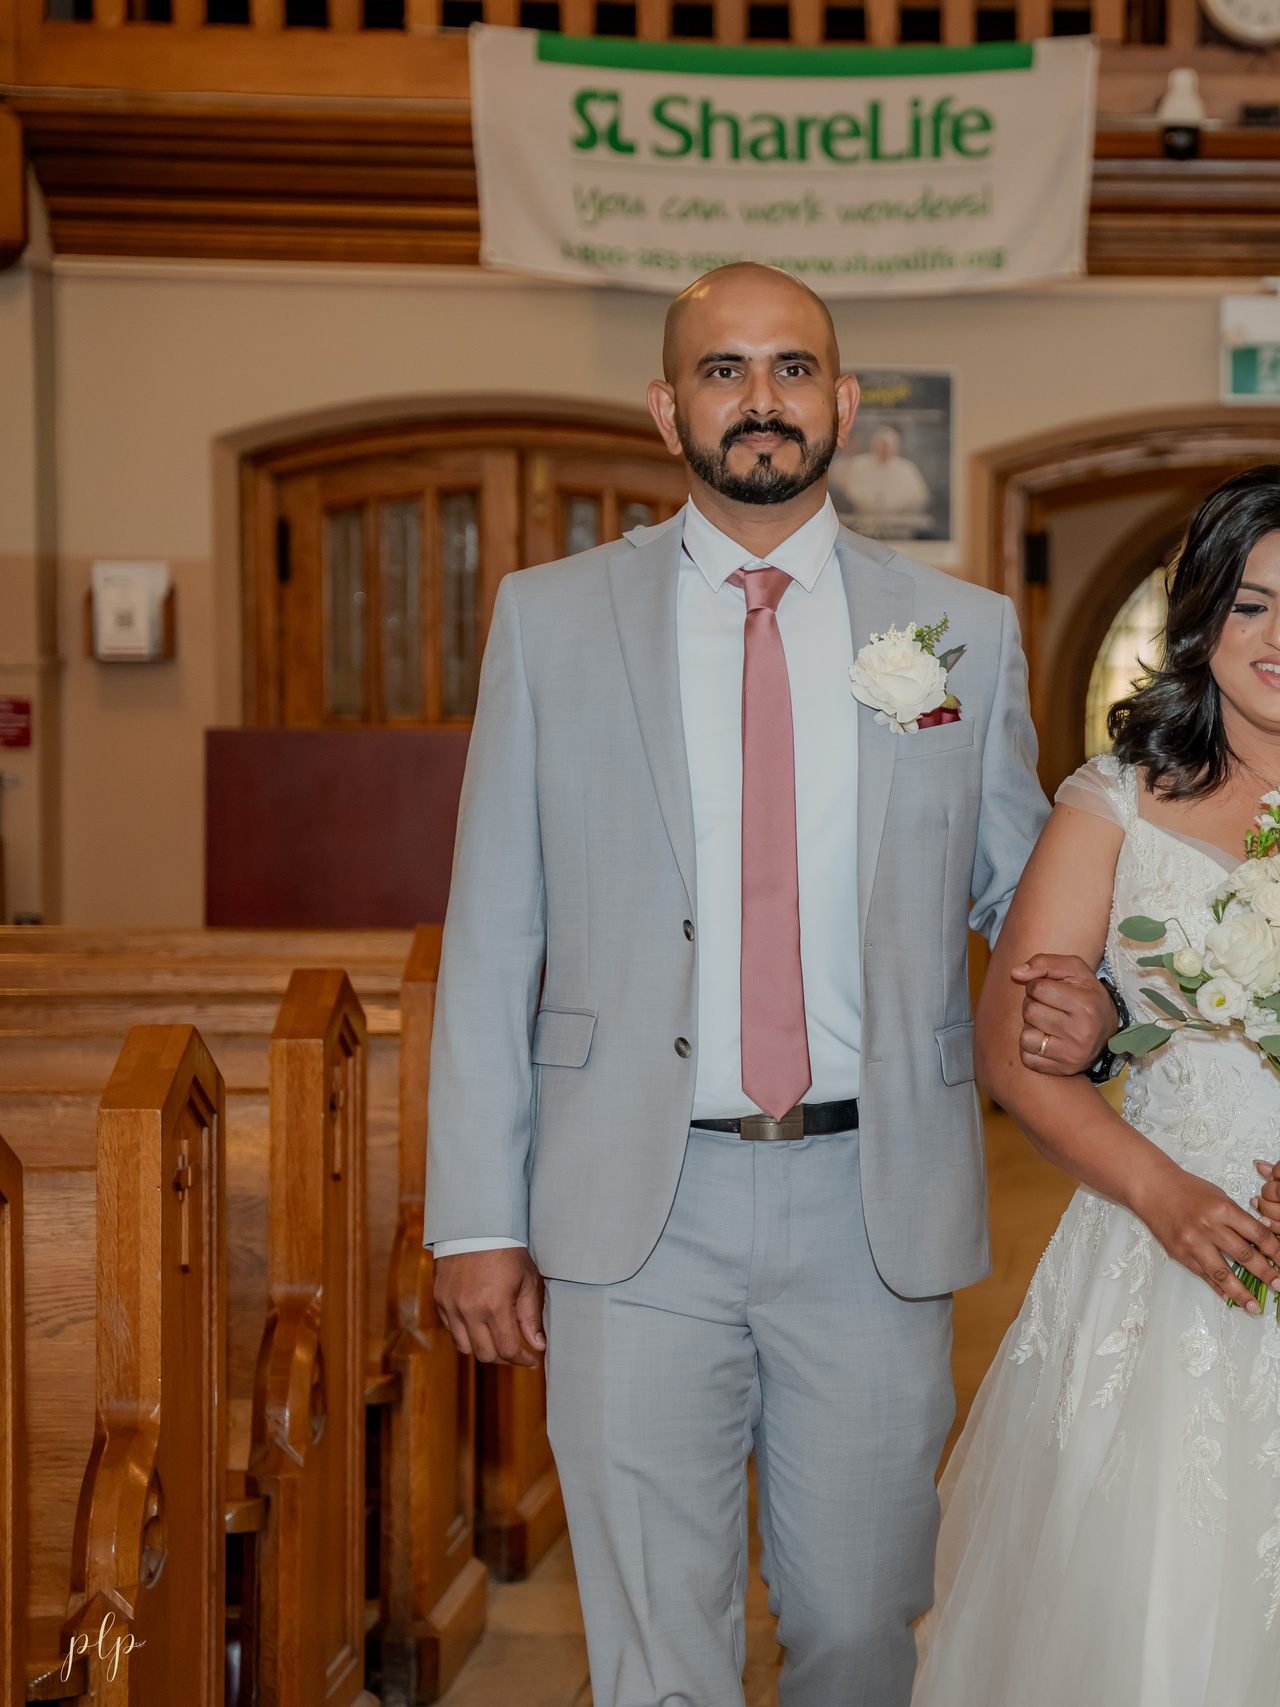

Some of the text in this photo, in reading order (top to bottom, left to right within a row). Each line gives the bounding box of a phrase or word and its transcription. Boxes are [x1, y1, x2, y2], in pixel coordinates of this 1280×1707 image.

[651, 95, 994, 163] ShareLife
[658, 193, 728, 224] can
[739, 188, 824, 226] work
